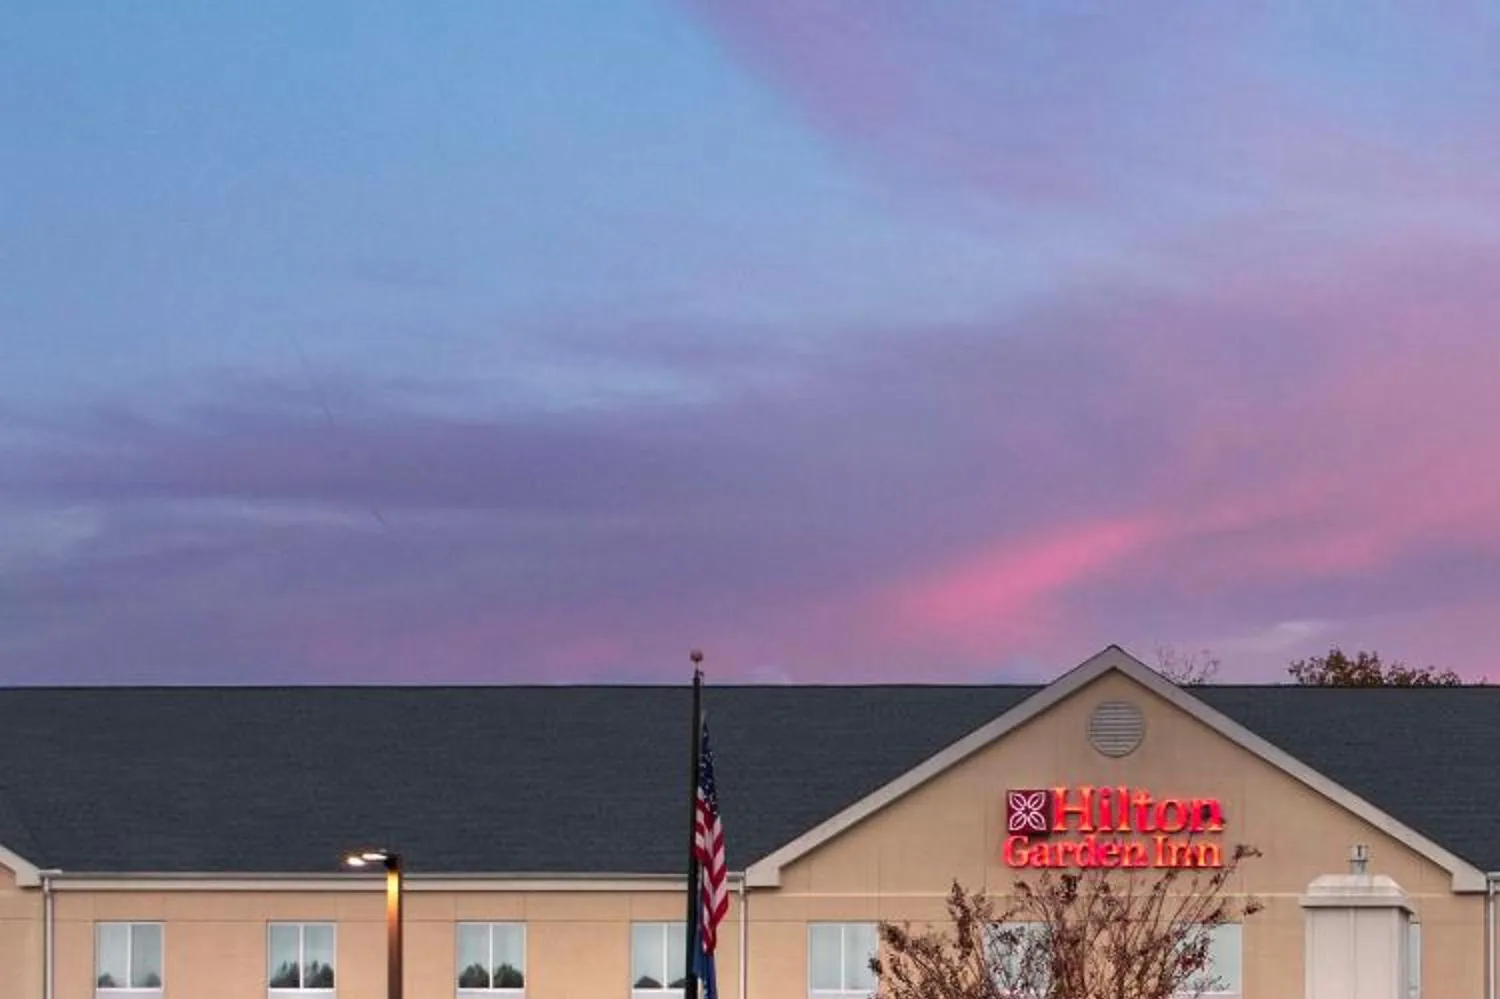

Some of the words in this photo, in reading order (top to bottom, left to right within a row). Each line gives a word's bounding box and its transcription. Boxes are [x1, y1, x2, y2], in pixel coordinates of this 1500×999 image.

[1052, 787, 1224, 832] Hilton
[1003, 835, 1148, 868] Garden
[1152, 835, 1223, 868] Inn
